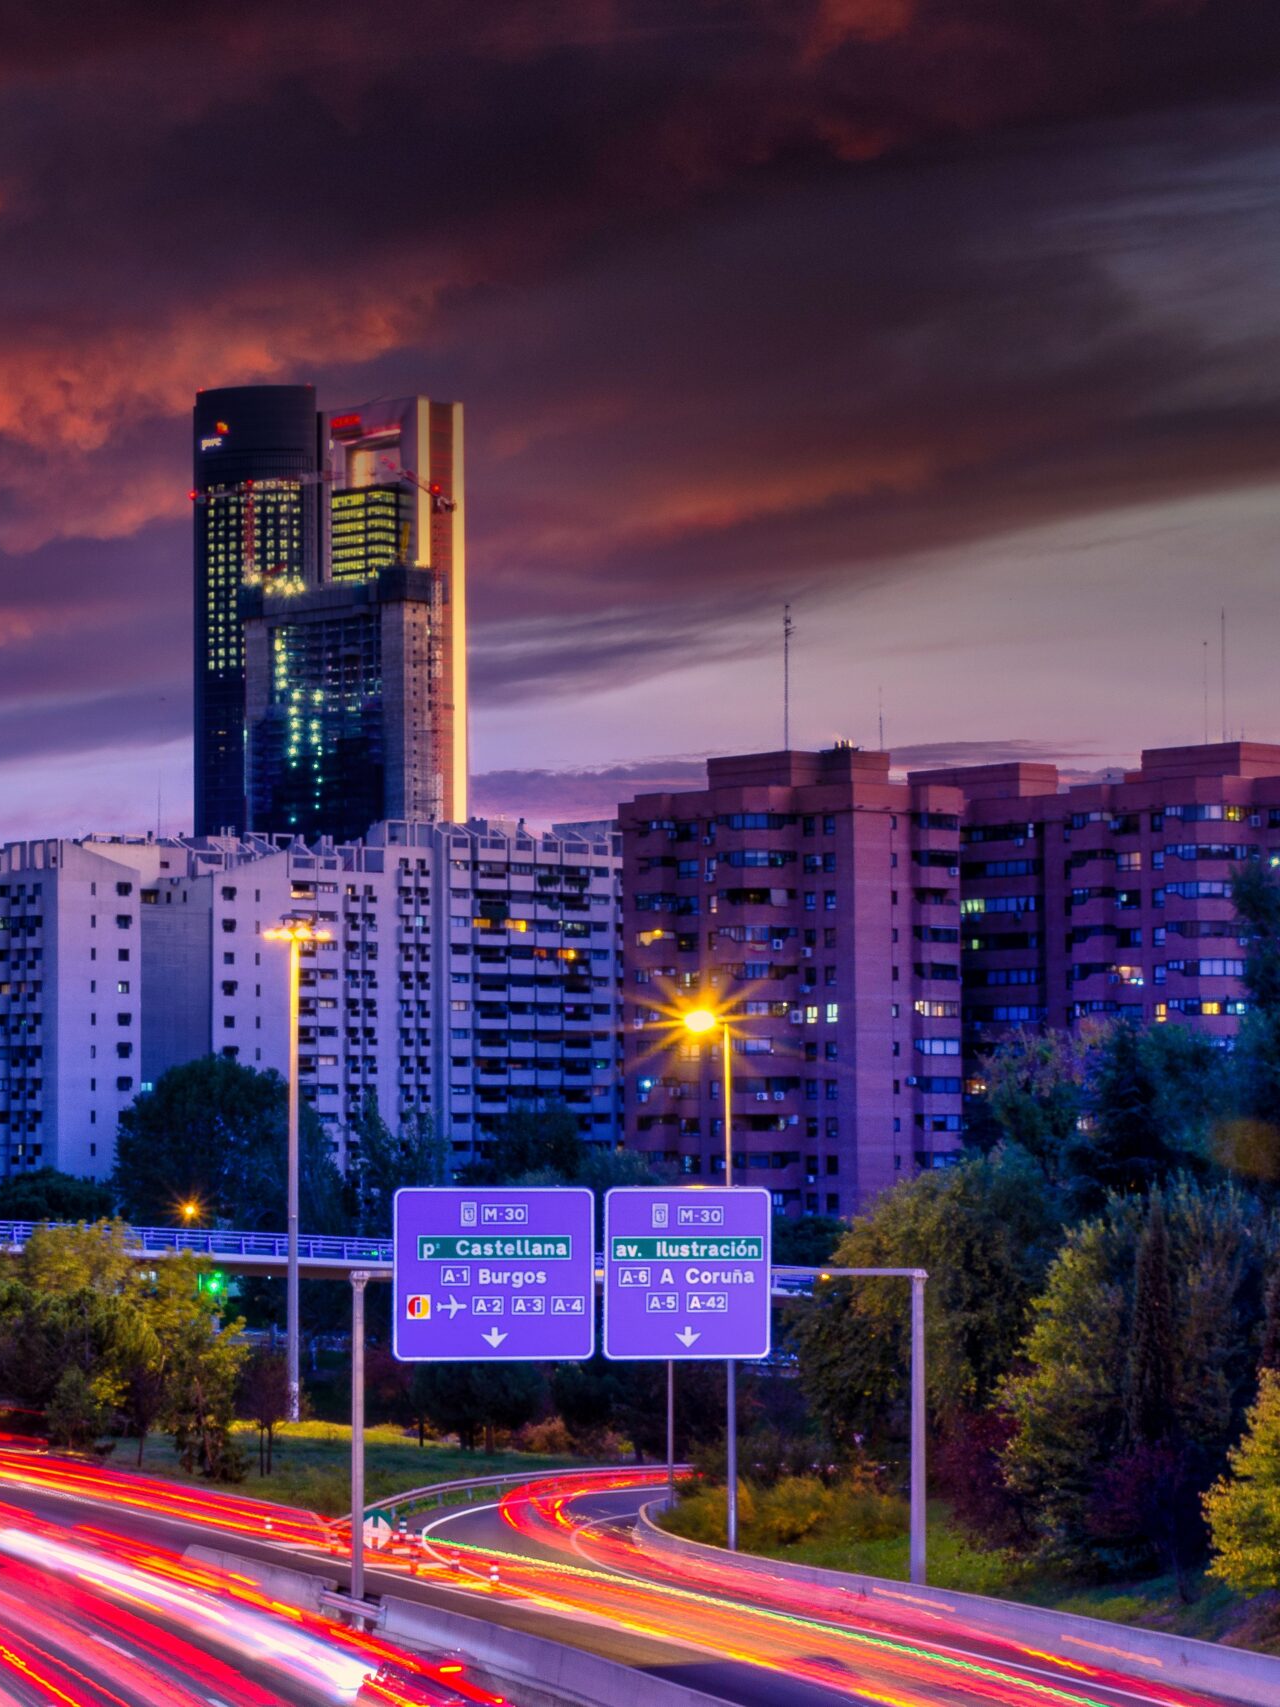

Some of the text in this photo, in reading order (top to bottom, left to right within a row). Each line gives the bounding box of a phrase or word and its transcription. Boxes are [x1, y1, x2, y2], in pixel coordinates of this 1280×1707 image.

[484, 1208, 525, 1221] M-30
[680, 1209, 721, 1222] M-30
[455, 1239, 567, 1256] Castellana
[616, 1240, 758, 1257] av. Ilustración
[443, 1268, 547, 1288] A-1 Burgos
[622, 1267, 755, 1285] A-6 A Coruña
[475, 1299, 582, 1312] A-2 A-3 A-4
[649, 1296, 725, 1309] A-5 A-42
